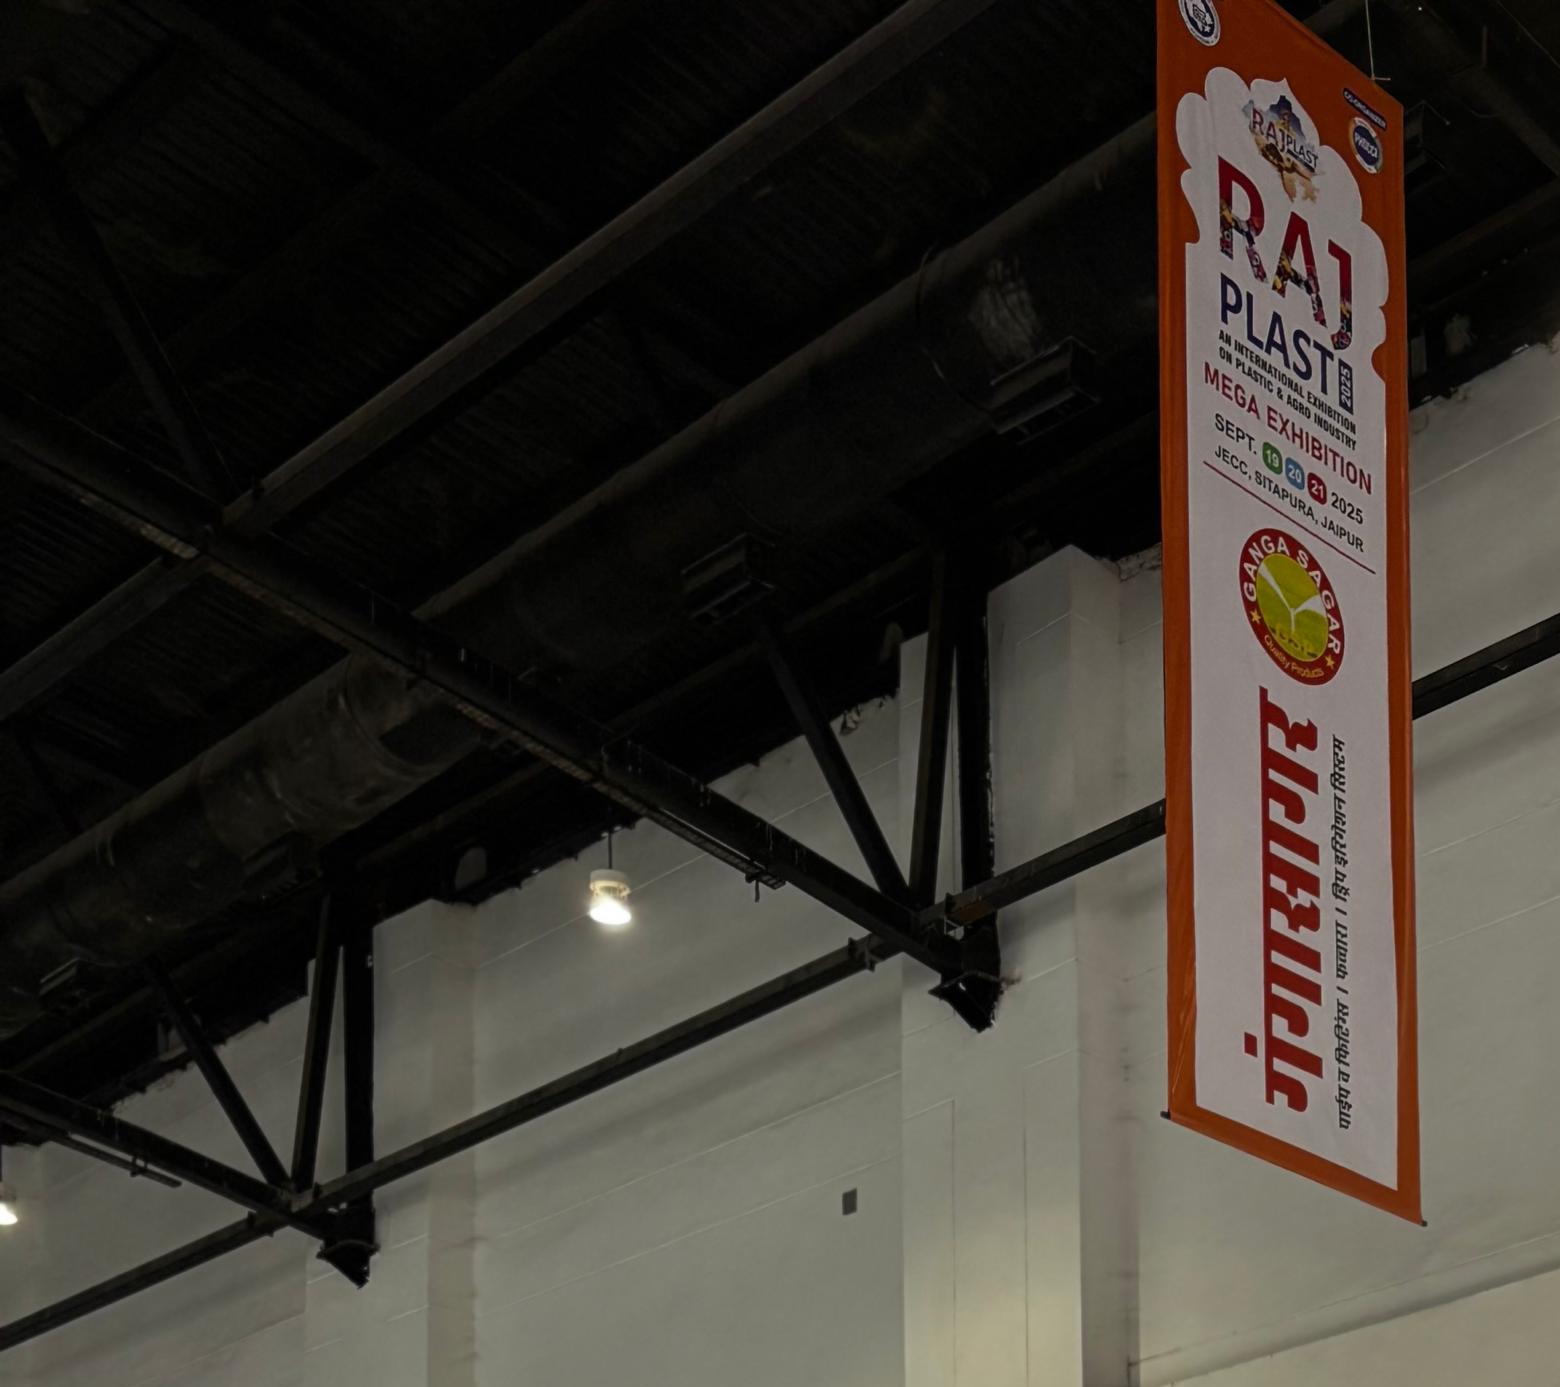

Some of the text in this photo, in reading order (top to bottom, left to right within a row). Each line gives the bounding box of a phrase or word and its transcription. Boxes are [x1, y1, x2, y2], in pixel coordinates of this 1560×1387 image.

[1218, 155, 1352, 350] RAJ
[1219, 330, 1356, 435] AN INTERNATIONAL EXHIBITION
[1220, 272, 1334, 395] PLAST
[1204, 362, 1372, 495] MEGA EXHIBITION
[1219, 347, 1357, 451] ON PLASTIC & AGRO INDUSTRY
[1215, 413, 1364, 525] SEPT. 19 20 21 2025
[1215, 445, 1364, 552] JECC, SITAPURA, JAIPUR
[1242, 534, 1341, 654] GANGA SAGAR
[1330, 734, 1347, 794] सिस्टम
[1243, 685, 1324, 1113] गंगासागर
[1335, 1086, 1352, 1130] पाईप
